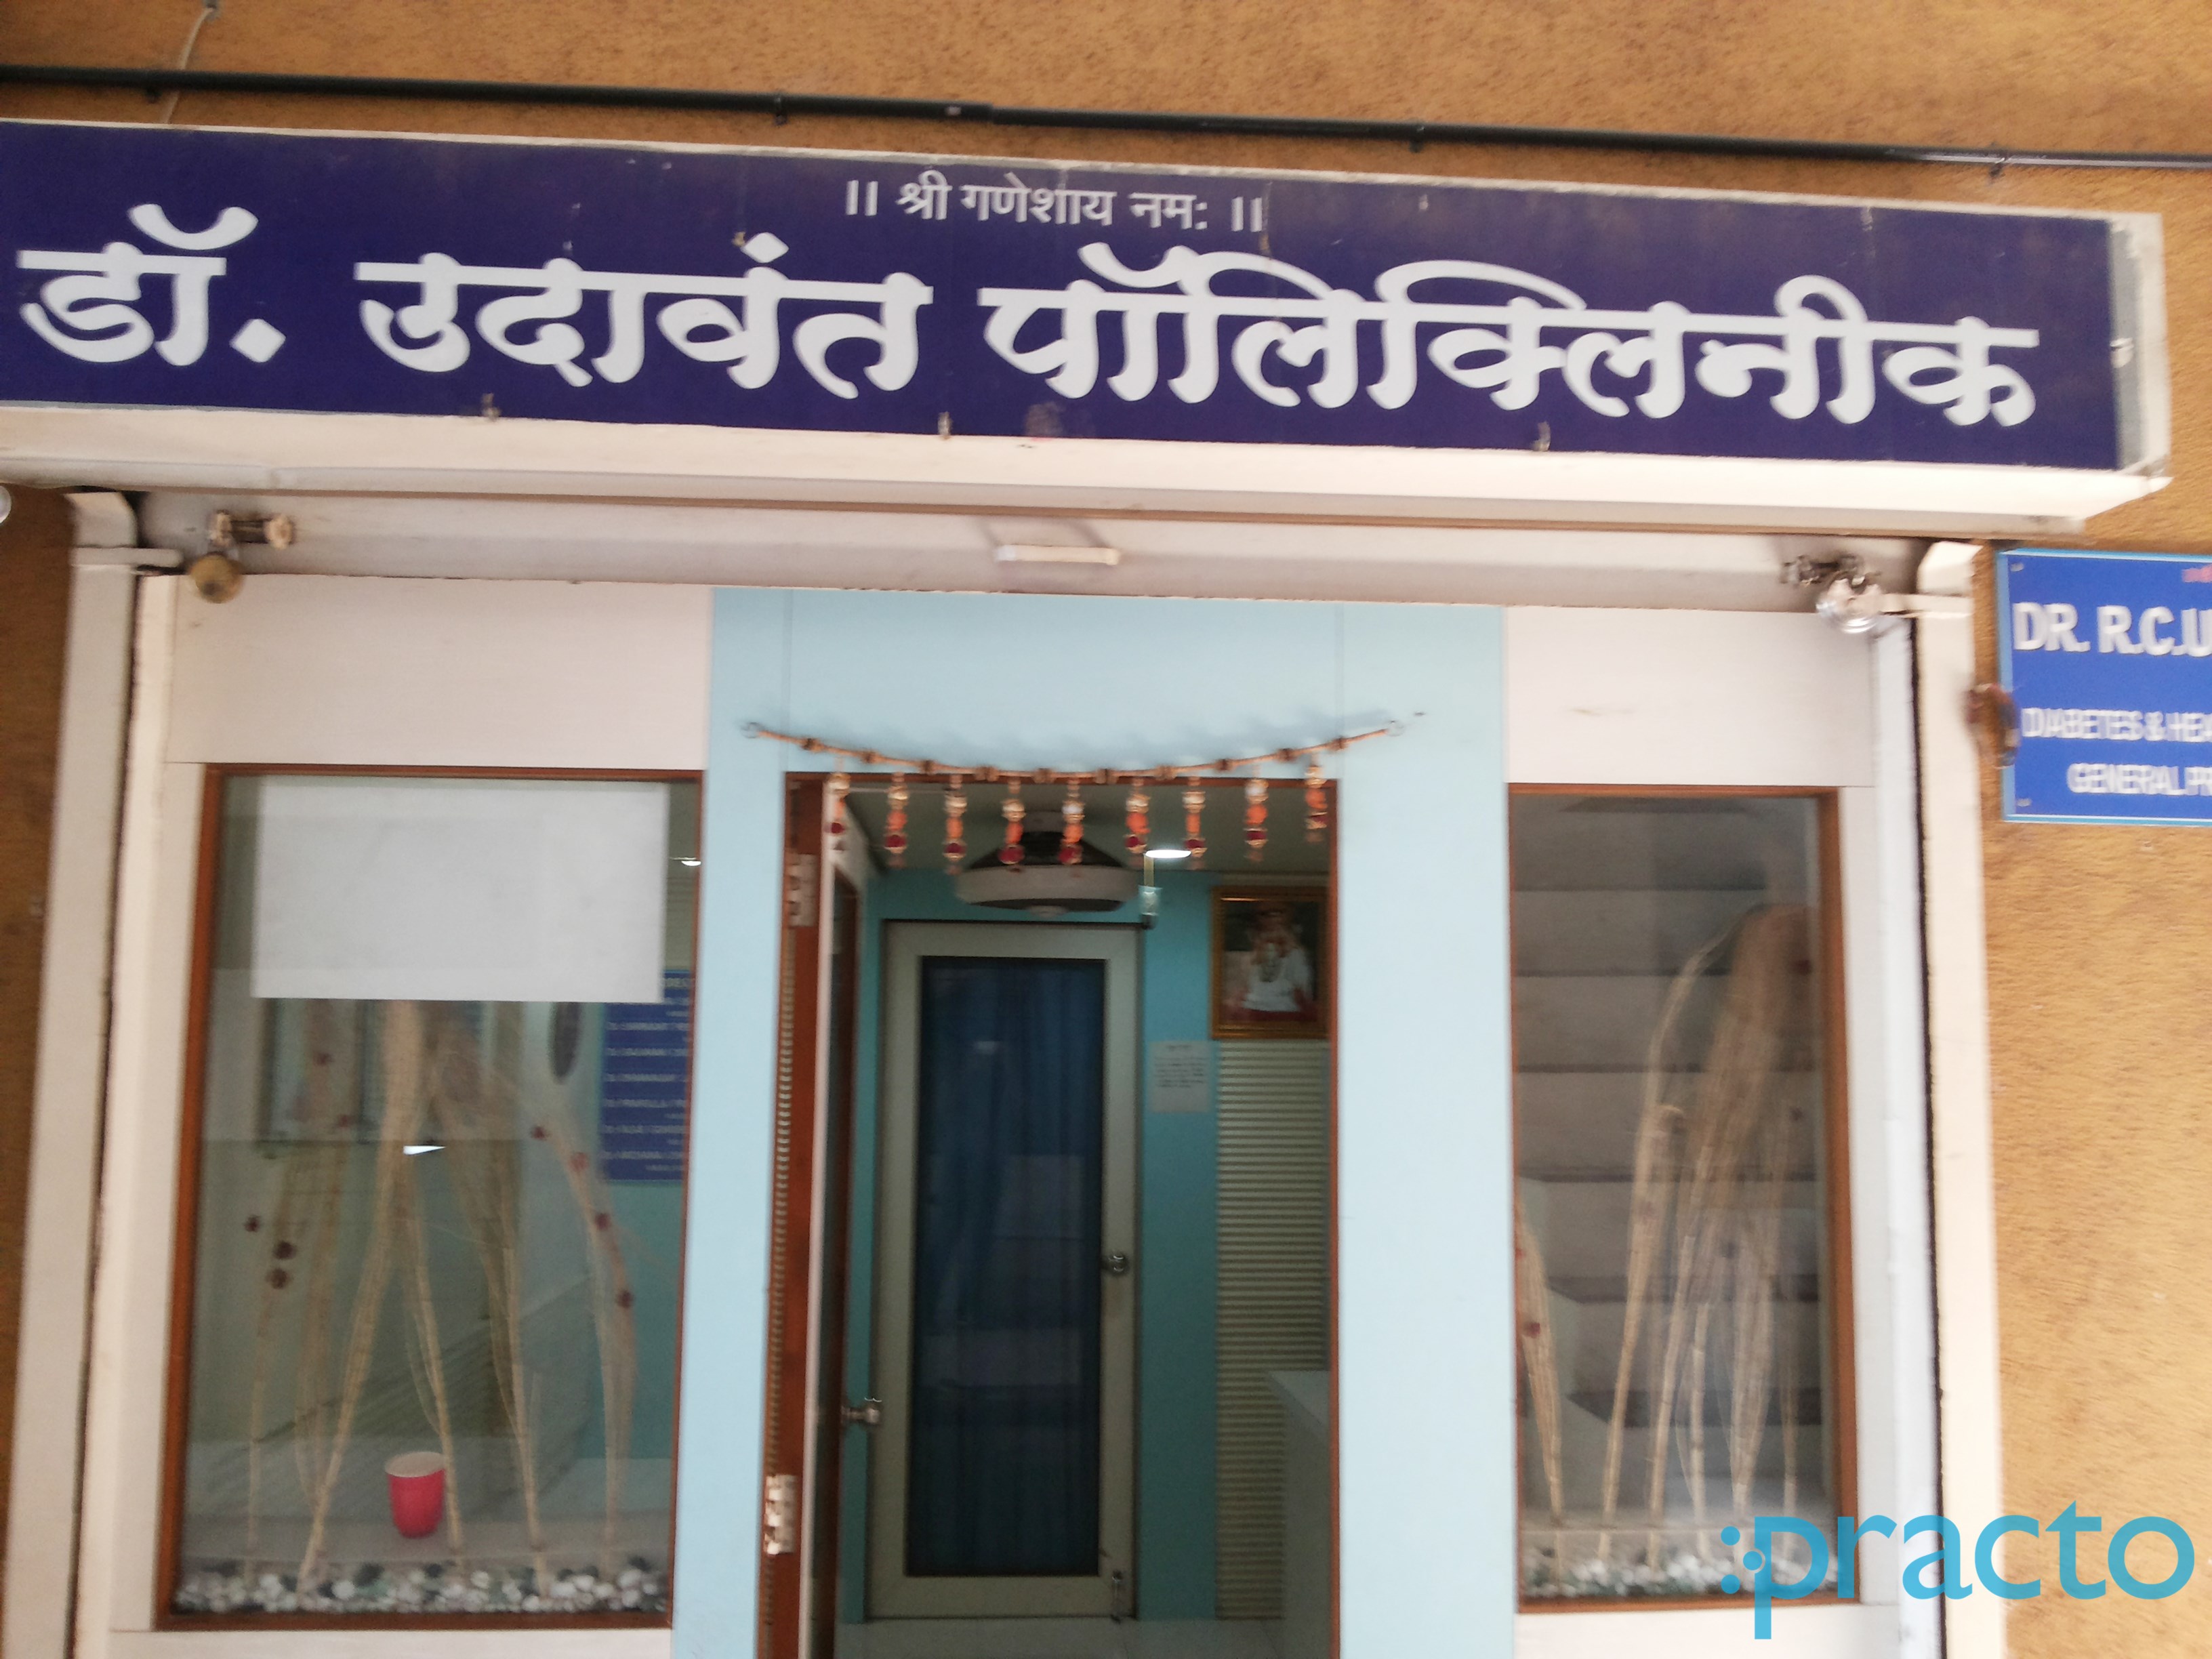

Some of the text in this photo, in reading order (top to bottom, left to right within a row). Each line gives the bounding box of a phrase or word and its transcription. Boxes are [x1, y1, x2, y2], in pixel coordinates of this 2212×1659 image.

[896, 169, 953, 222] श्री
[960, 171, 1117, 226] गणेशाय
[16, 203, 2041, 428] डॉ. उदावंत पॉलिक्लिनीक
[2013, 602, 2091, 653] DR.
[2021, 707, 2144, 741] DIABETES
[2144, 710, 2167, 741] &
[2067, 762, 2186, 796] GENERAL
